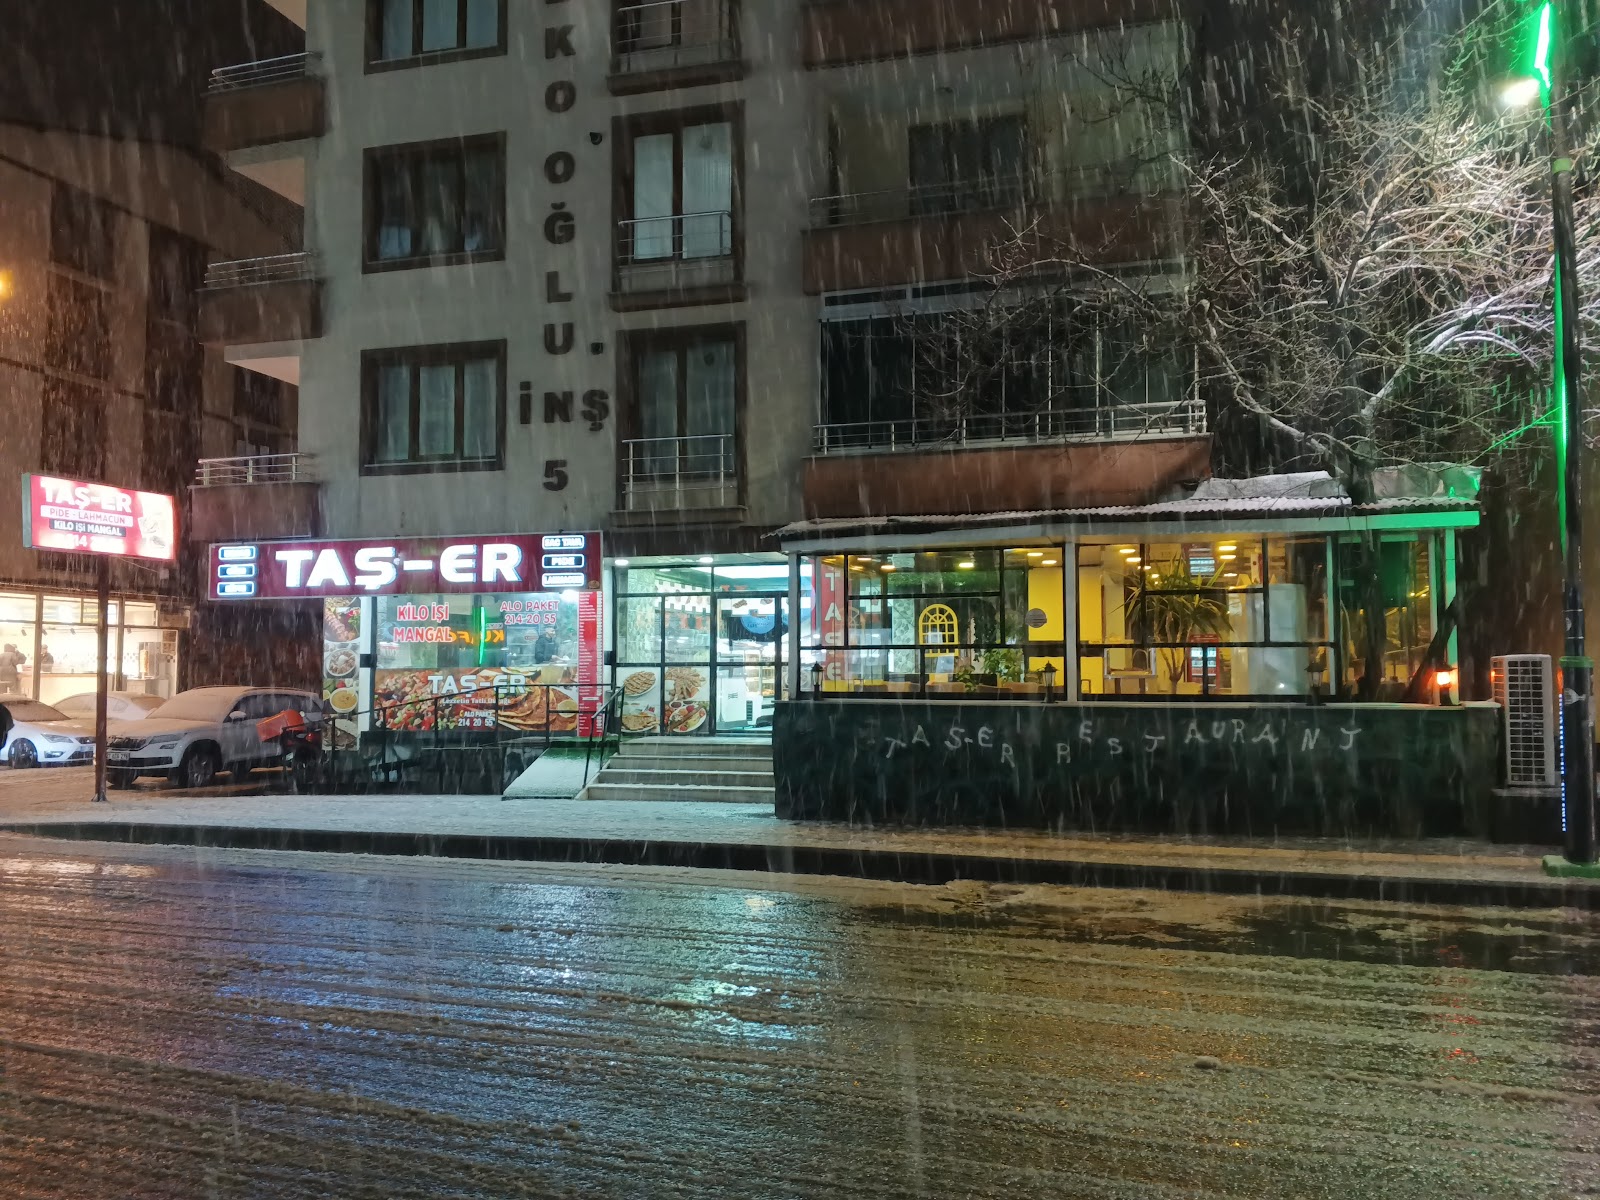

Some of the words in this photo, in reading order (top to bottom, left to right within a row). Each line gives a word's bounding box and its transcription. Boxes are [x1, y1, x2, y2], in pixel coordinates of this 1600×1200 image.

[542, 459, 569, 492] 5
[41, 477, 132, 513] TAŞ-ER
[78, 511, 126, 525] LAHMACUN
[87, 524, 122, 536] MANGAL
[275, 543, 523, 590] TAŞ-ER
[397, 602, 429, 621] KİLO
[431, 602, 449, 623] İŞİ
[500, 601, 522, 612] ALO
[526, 600, 560, 611] PAKET
[504, 614, 523, 625] 214
[526, 613, 541, 624] 20
[543, 612, 557, 624] 55
[393, 626, 453, 643] MANGAL
[427, 674, 526, 698] TAŞ-ER
[458, 718, 470, 727] 214
[472, 718, 482, 726] 20
[484, 718, 494, 726] 55
